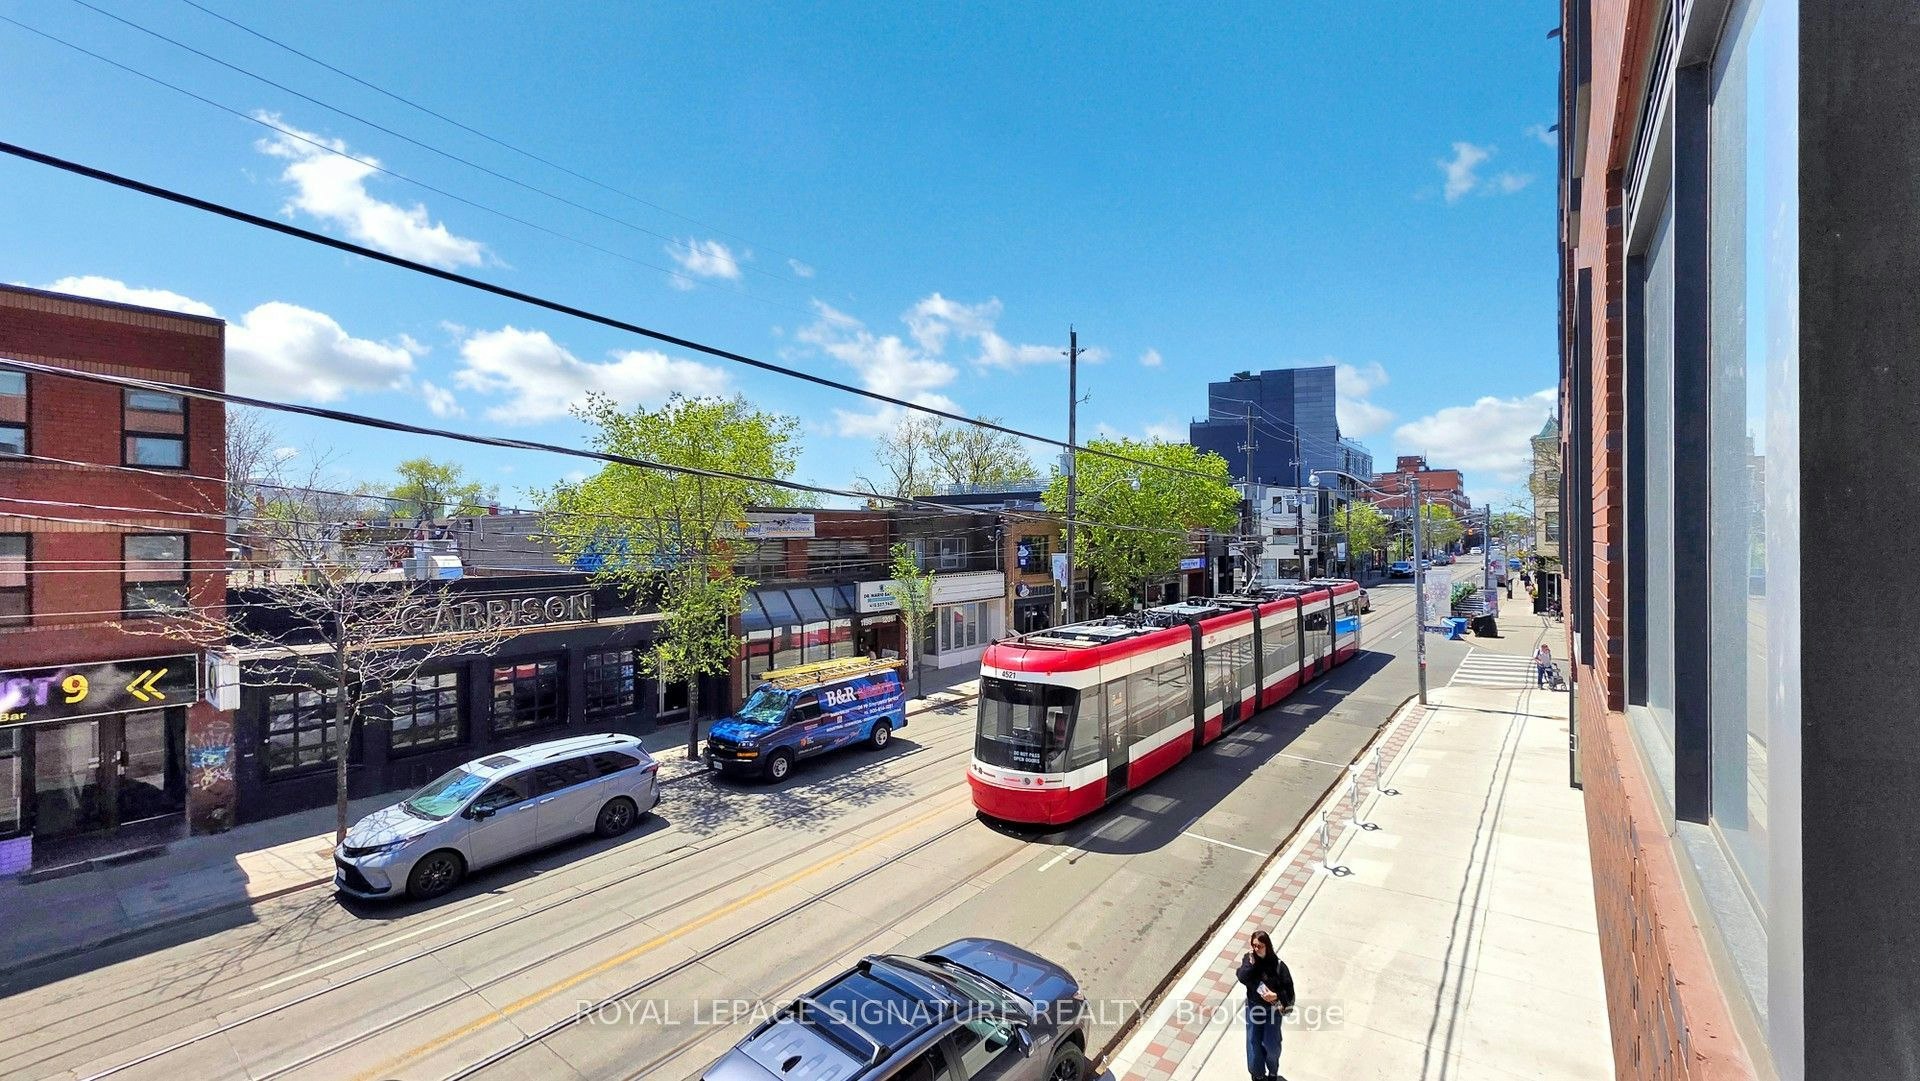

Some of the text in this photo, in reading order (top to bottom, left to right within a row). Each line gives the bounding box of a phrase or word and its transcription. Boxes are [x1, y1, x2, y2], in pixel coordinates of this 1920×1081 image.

[401, 594, 593, 635] GARRISON
[1002, 671, 1016, 679] 4521
[61, 674, 89, 704] 9
[825, 686, 857, 707] B&R
